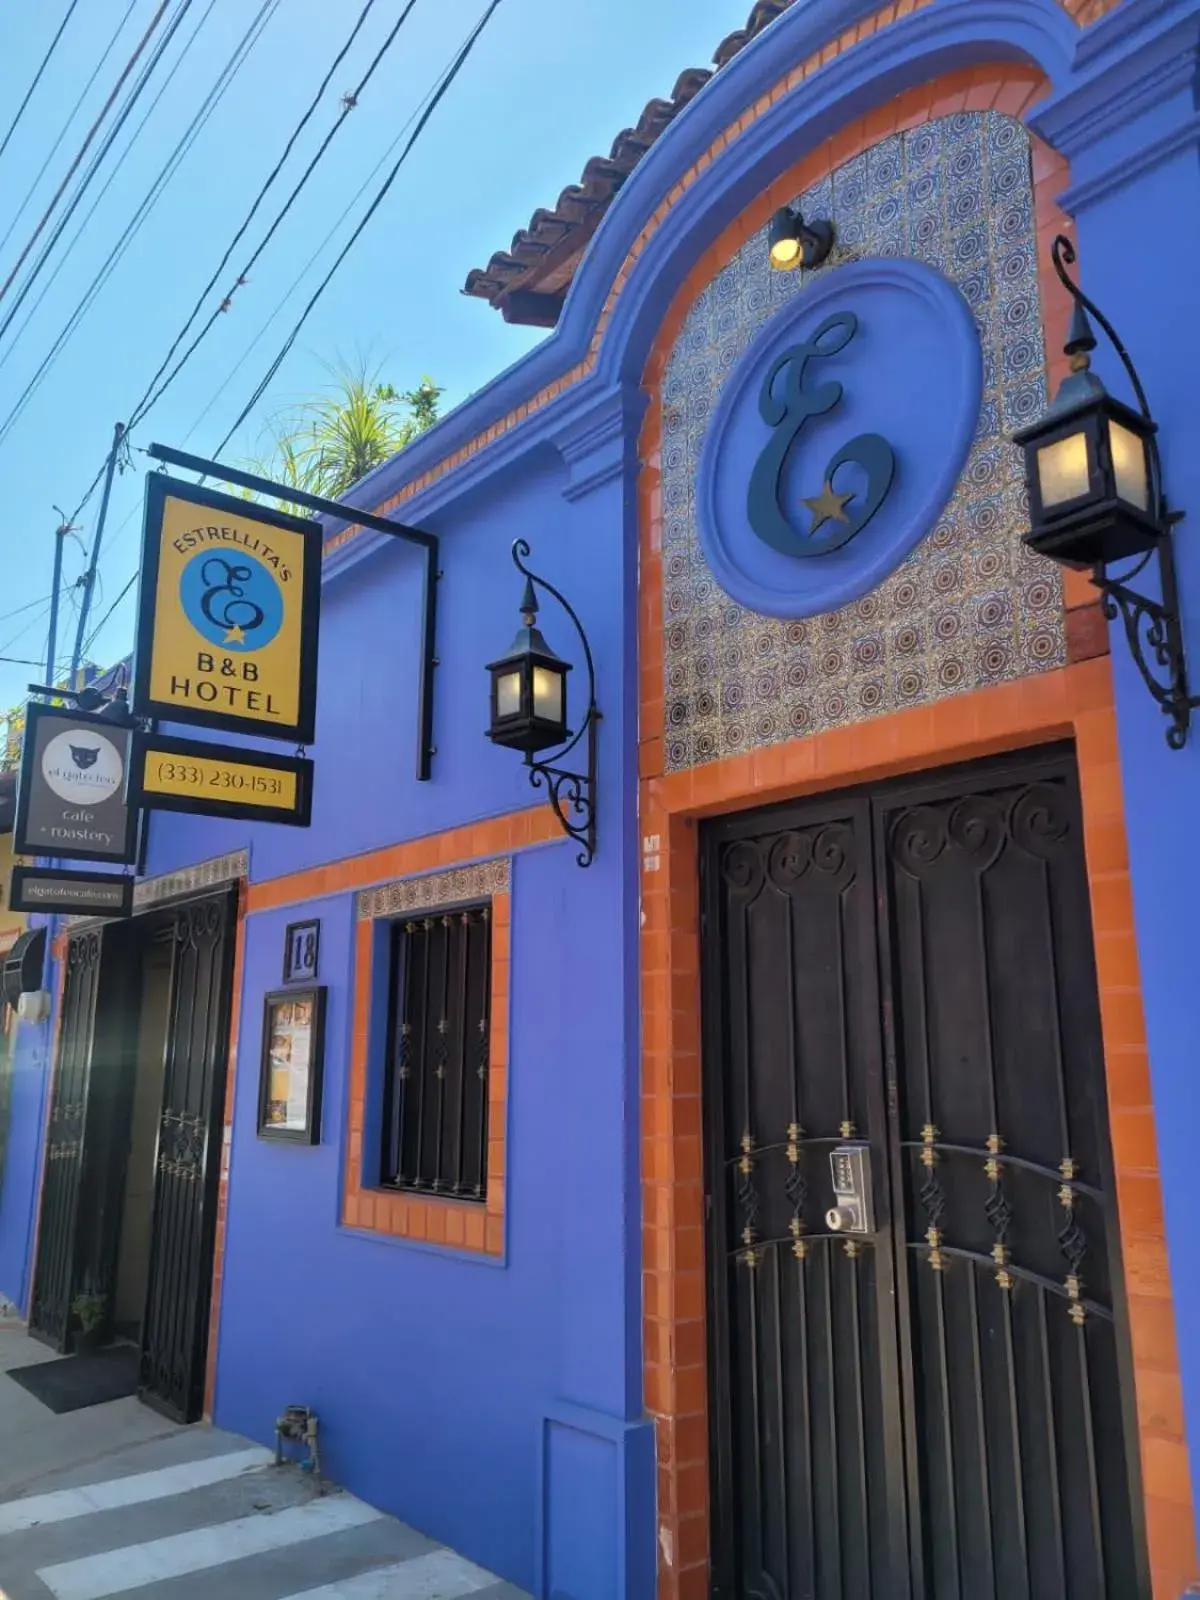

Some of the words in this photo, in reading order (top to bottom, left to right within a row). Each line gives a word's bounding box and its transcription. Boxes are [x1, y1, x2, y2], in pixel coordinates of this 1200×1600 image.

[172, 526, 292, 582] ESTRELLITA'S
[198, 652, 258, 683] B&B
[171, 676, 281, 715] HOTEL
[158, 763, 204, 787] (333)
[209, 771, 282, 795] 230-1531
[51, 827, 112, 847] roastery
[293, 933, 315, 970] 18
